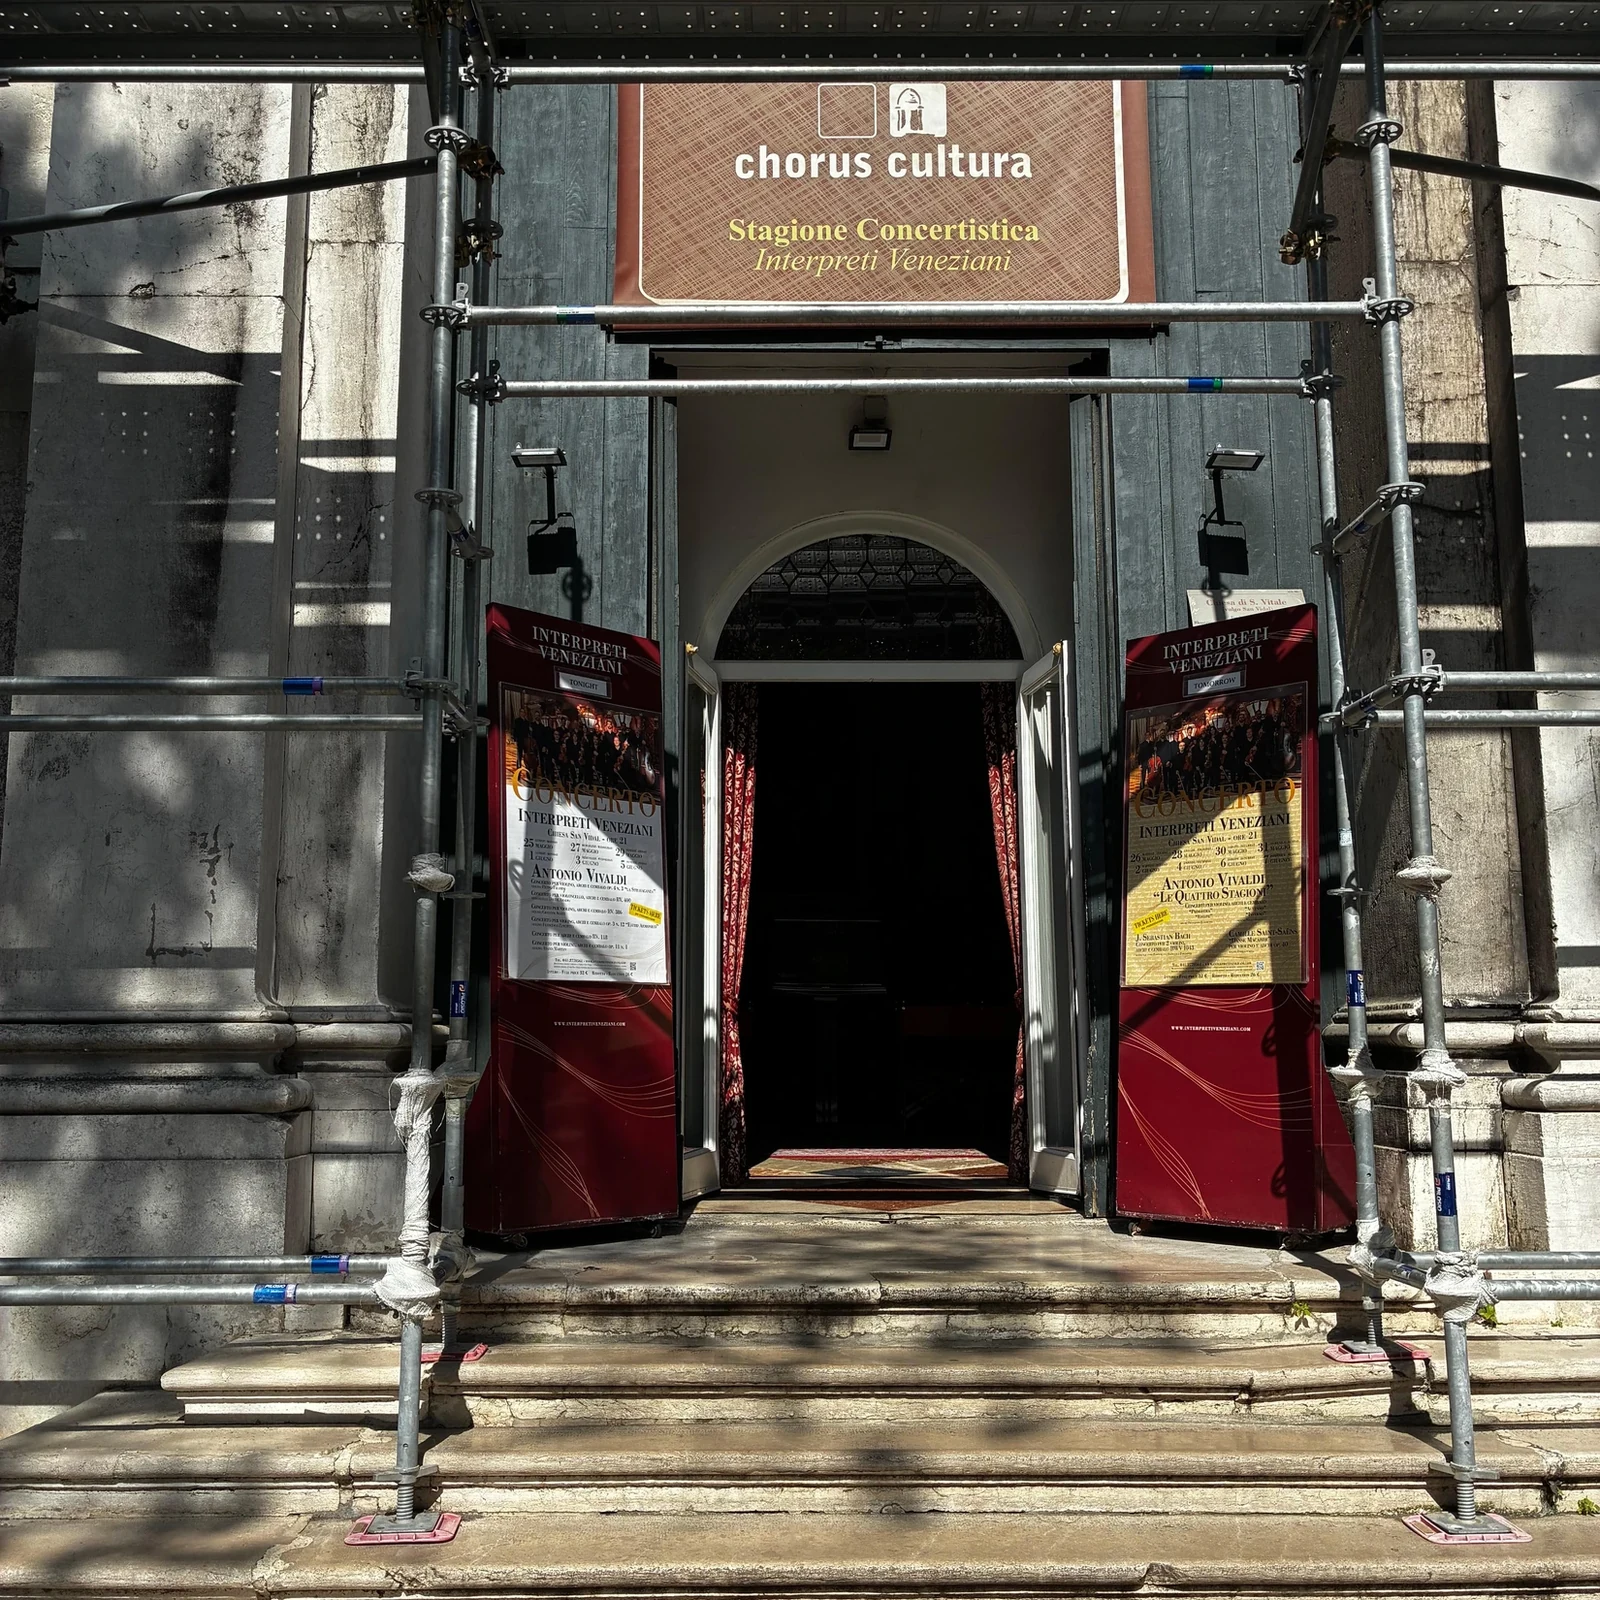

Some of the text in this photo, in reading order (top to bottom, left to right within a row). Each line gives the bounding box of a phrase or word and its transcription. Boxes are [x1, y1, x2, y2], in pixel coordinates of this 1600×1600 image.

[735, 144, 1033, 180] chorus cultura
[729, 217, 1039, 247] Stagione Concertistica
[754, 248, 1012, 277] Interpreti Veneziani
[1238, 598, 1247, 606] di
[1260, 598, 1287, 606] Vitale
[532, 626, 627, 660] INTERPRETI
[1163, 626, 1269, 660] INTERPRETI
[538, 644, 623, 675] VENEZIANI
[1169, 645, 1262, 675] VENEZIANI
[569, 678, 598, 691] TONIGHT
[1193, 676, 1237, 690] TOMORROW
[1134, 776, 1296, 819] CONCERTO
[518, 808, 653, 837] INTERPRETI VENEZIANI
[1139, 813, 1290, 839] INTERPRETI VENEZIANI
[619, 836, 627, 845] 21
[1248, 831, 1257, 840] 21
[524, 838, 534, 848] 25
[570, 843, 581, 853] 27
[1257, 842, 1268, 852] 31
[615, 847, 625, 857] 29
[1171, 849, 1183, 860] 28
[1215, 846, 1227, 856] 30
[575, 855, 581, 865] 3
[1130, 852, 1141, 863] 26
[1220, 857, 1226, 868] 6
[620, 859, 626, 870] 5
[1135, 865, 1141, 875] 2
[531, 863, 627, 886] ANTONIO VIVALDI
[1162, 873, 1266, 891] ANTONIO VIVALDI
[1175, 889, 1220, 906] QUATTRO
[1174, 932, 1191, 940] BACH
